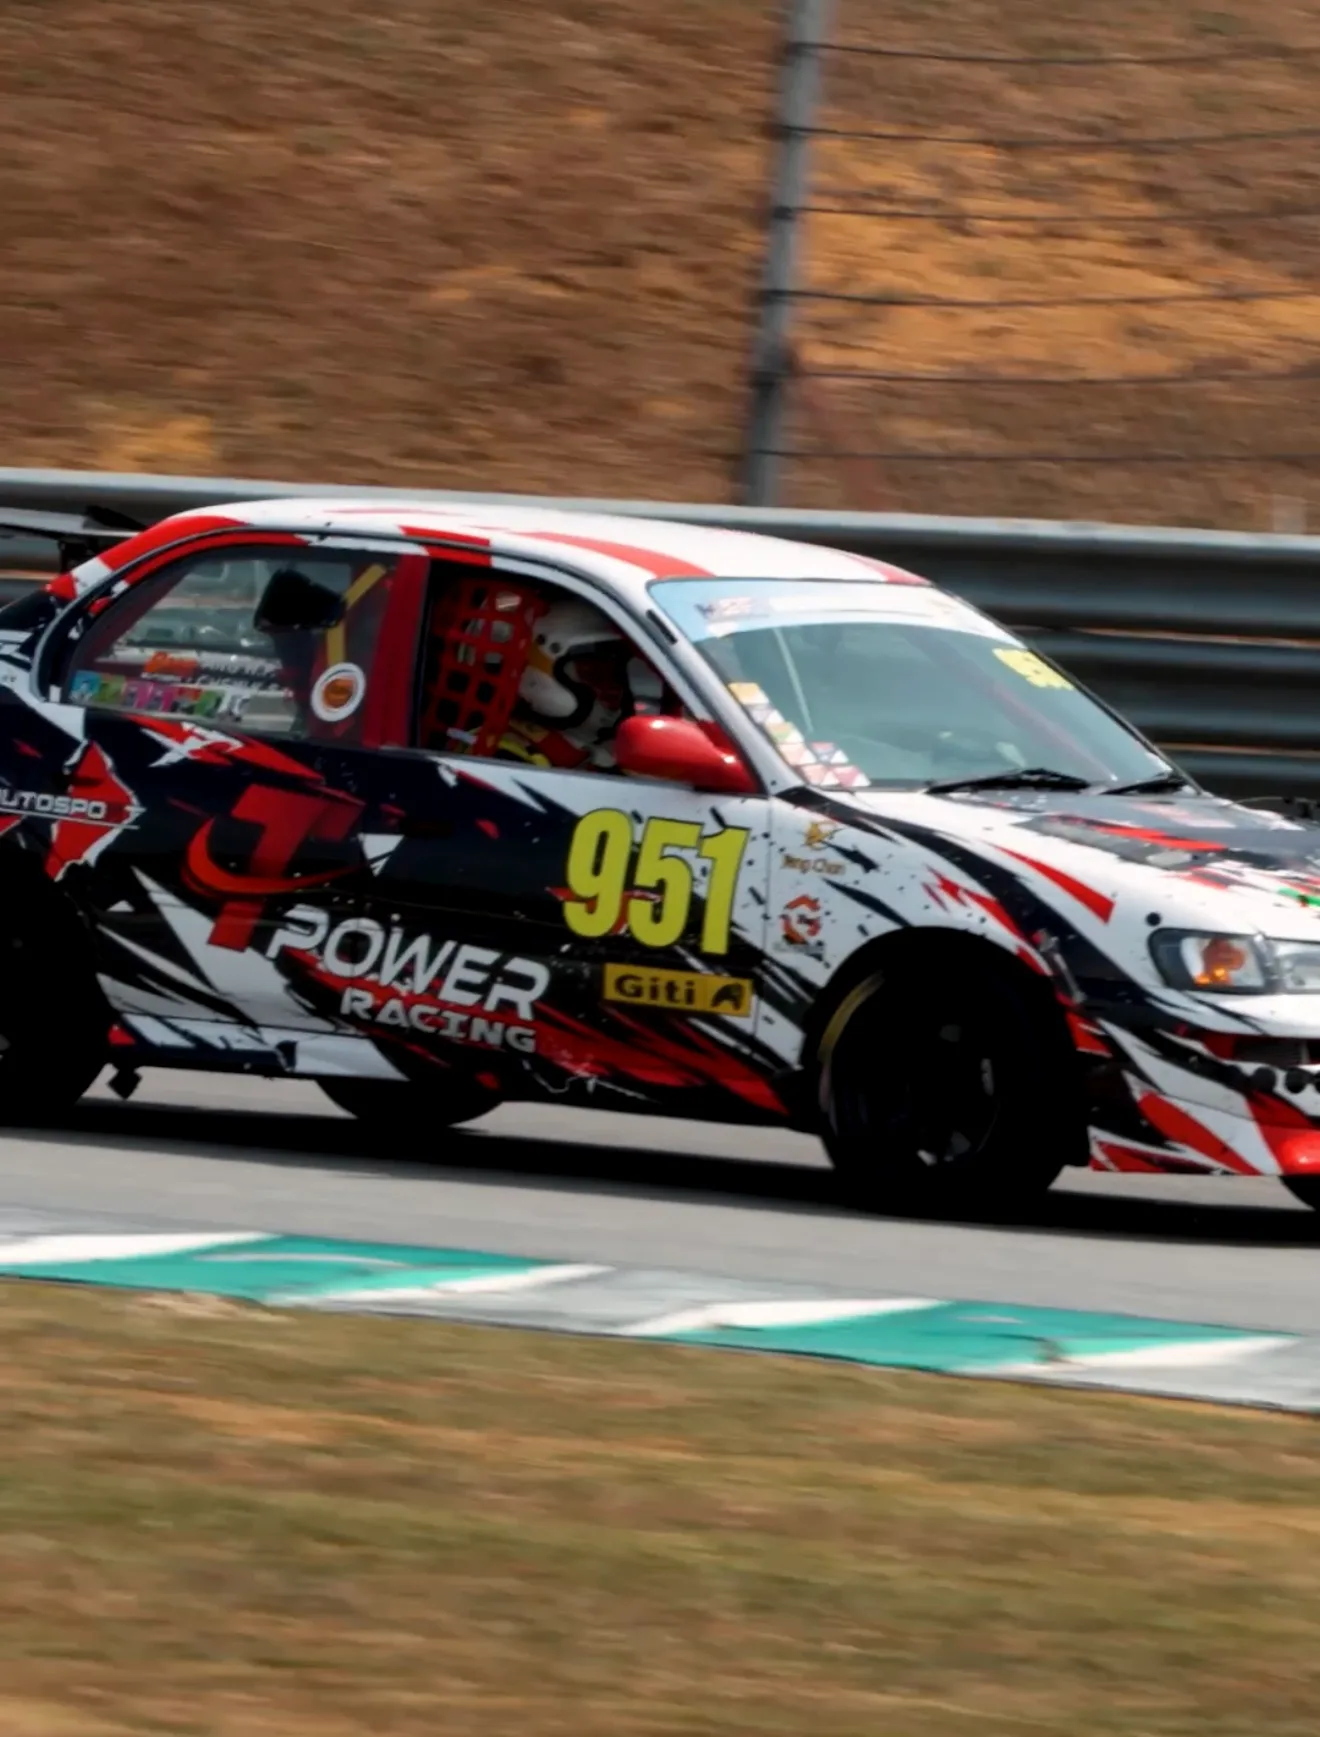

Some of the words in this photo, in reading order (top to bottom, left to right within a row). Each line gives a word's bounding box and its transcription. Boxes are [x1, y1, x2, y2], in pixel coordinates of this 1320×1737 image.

[0, 788, 107, 819] UTOSPO
[563, 807, 751, 955] 951
[266, 903, 551, 1021] POWER
[614, 973, 695, 1005] Giti
[340, 988, 536, 1053] RACING
